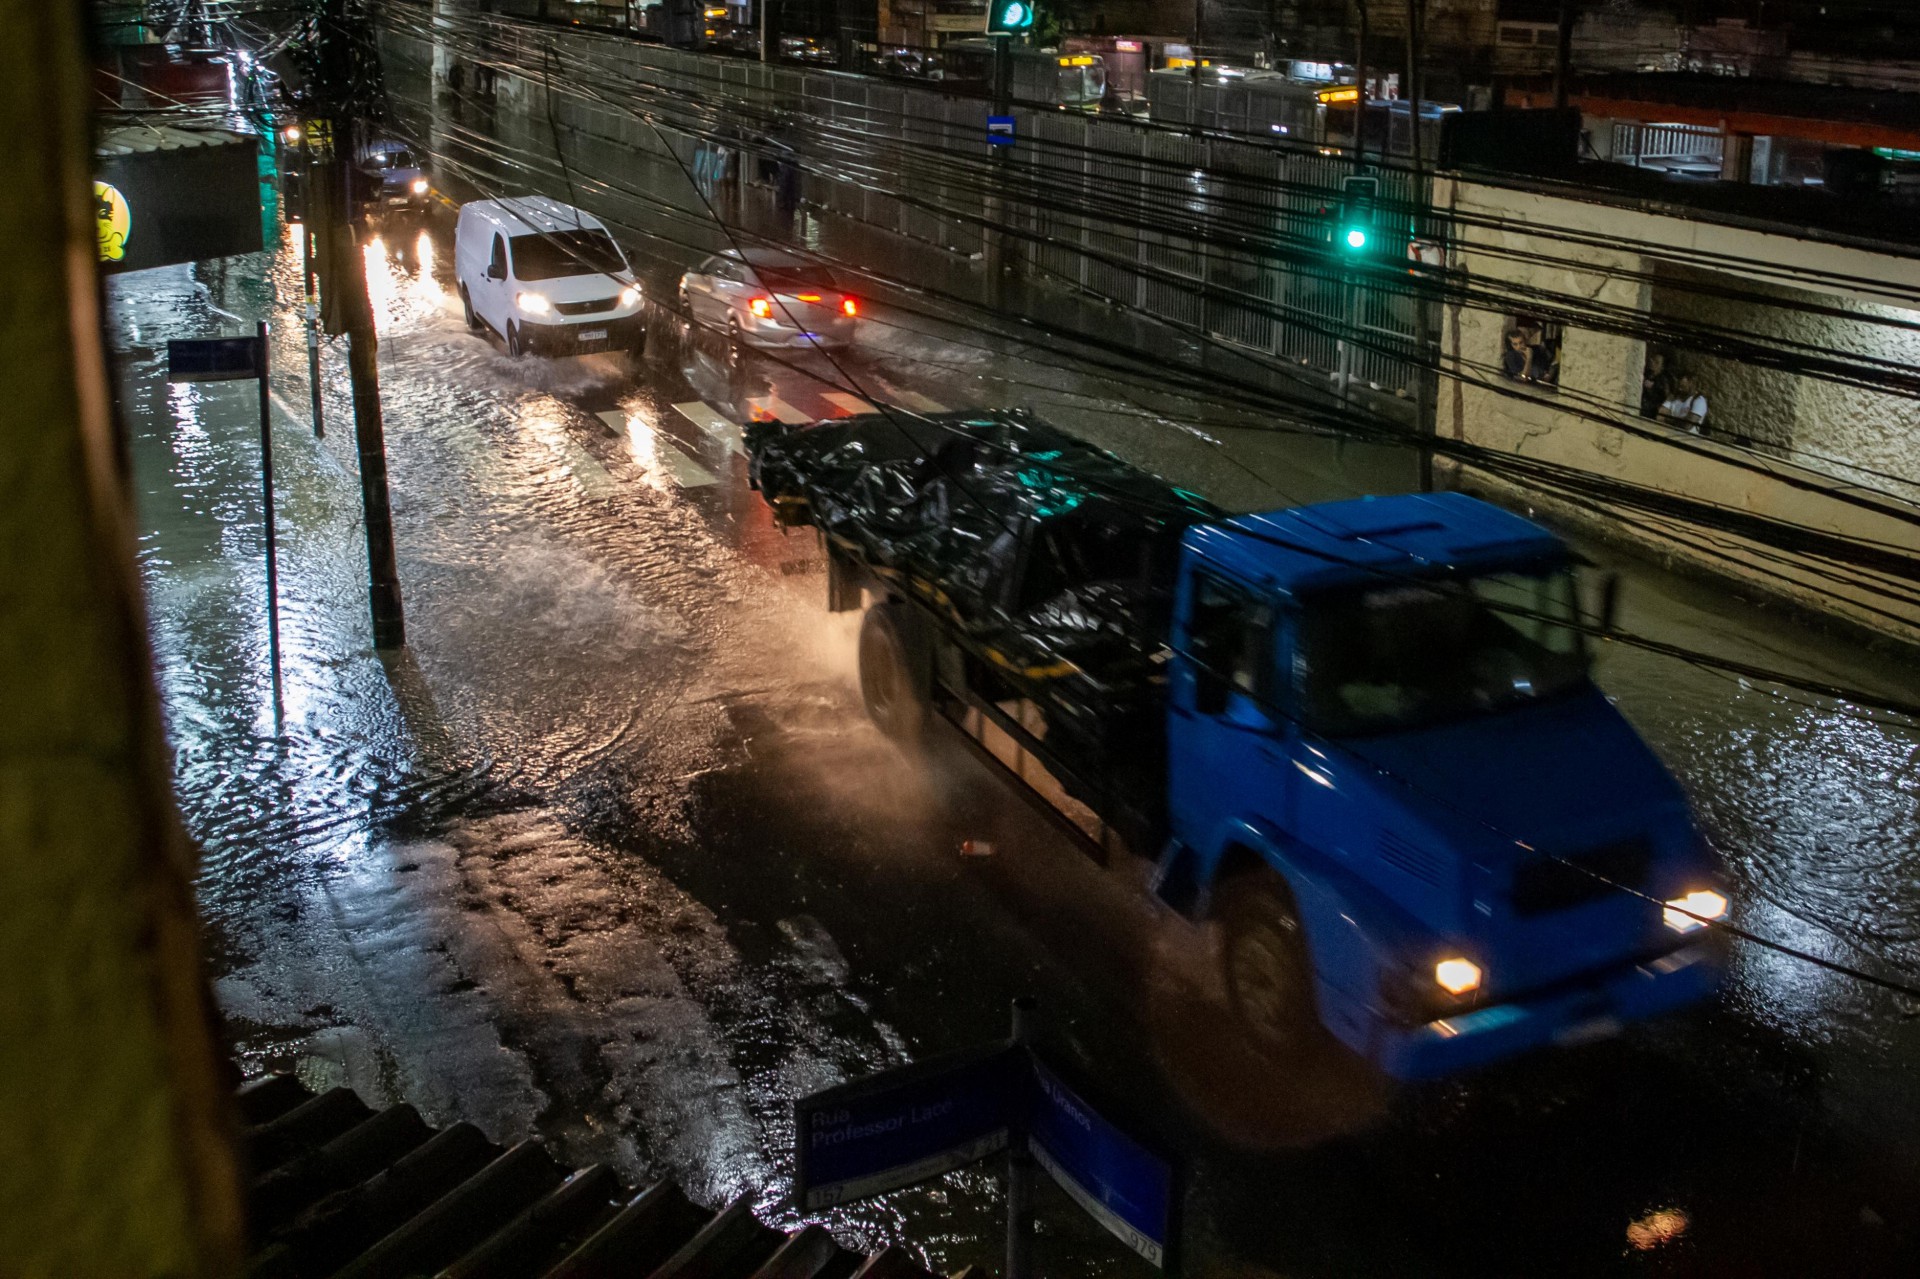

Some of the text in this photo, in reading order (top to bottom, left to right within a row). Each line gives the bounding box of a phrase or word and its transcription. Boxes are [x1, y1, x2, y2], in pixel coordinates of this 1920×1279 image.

[811, 1109, 851, 1129] Rua
[811, 1115, 906, 1150] Professor
[1130, 1233, 1158, 1262] 979
